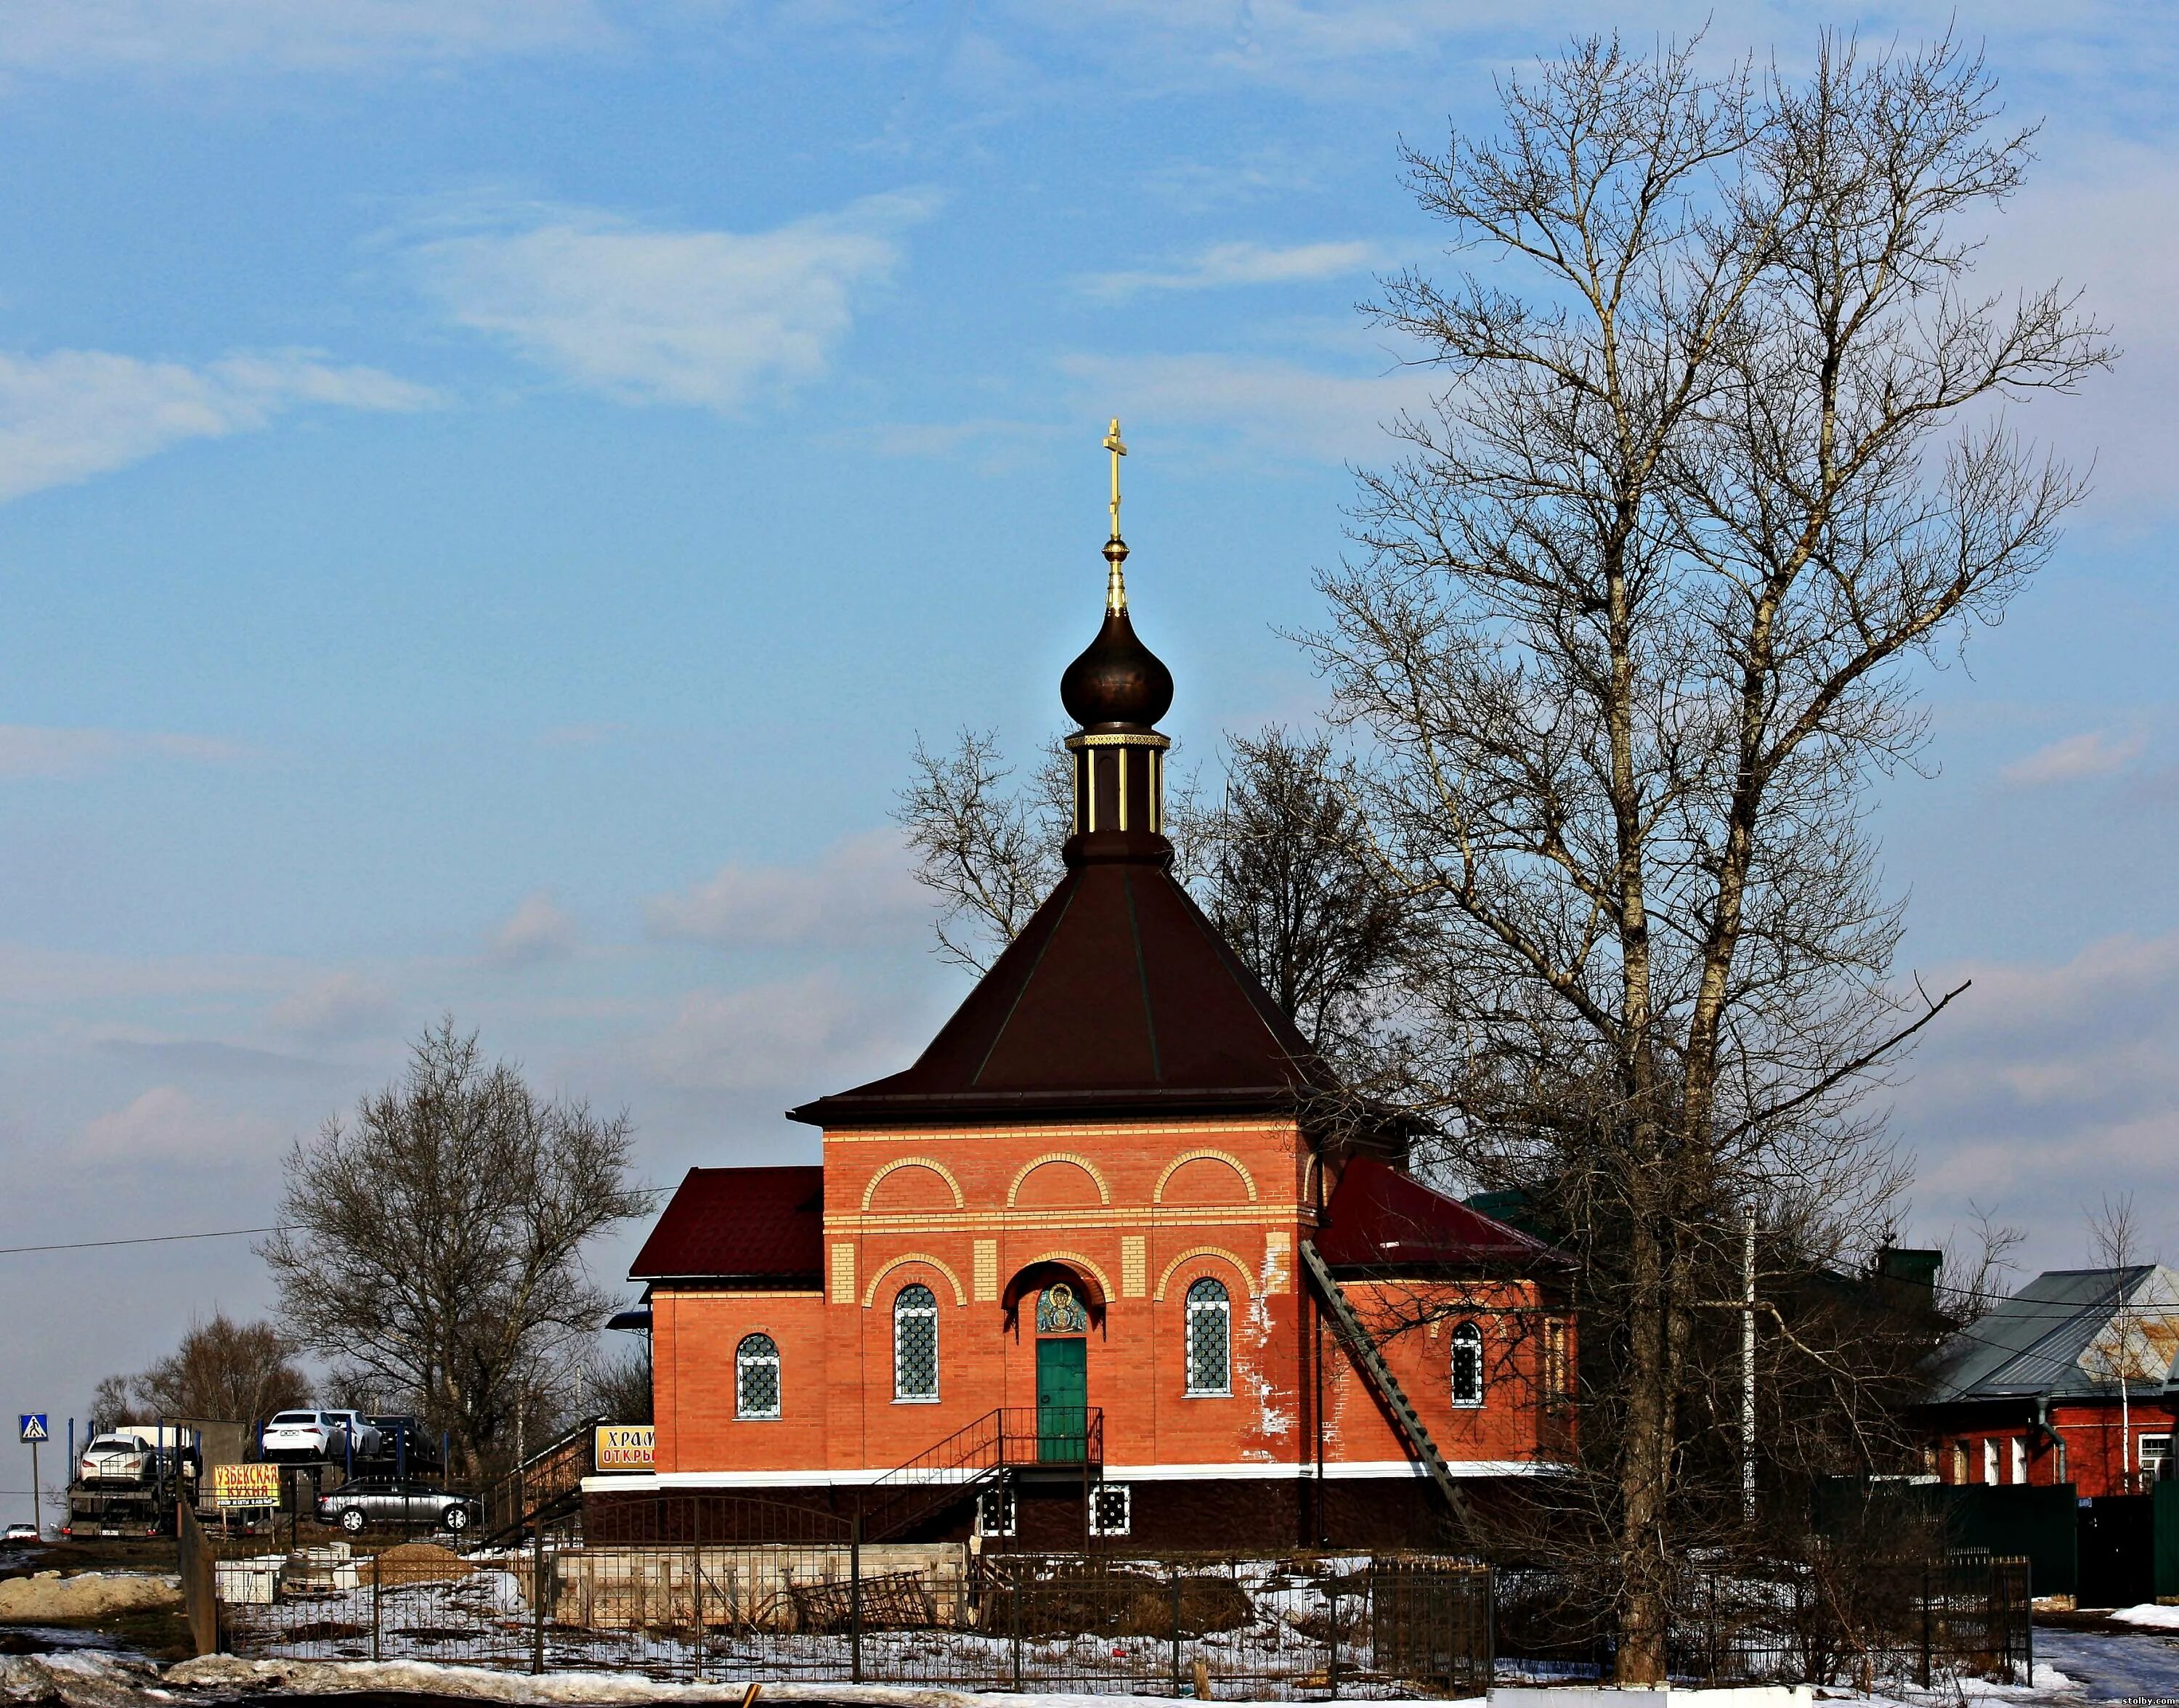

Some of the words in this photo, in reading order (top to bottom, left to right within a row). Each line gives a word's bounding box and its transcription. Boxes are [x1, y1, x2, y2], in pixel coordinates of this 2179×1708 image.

[607, 1431, 656, 1447] ХРАМ
[215, 1465, 277, 1487] УЗБЕКСКАЯ
[227, 1485, 268, 1497] КУХНЯ
